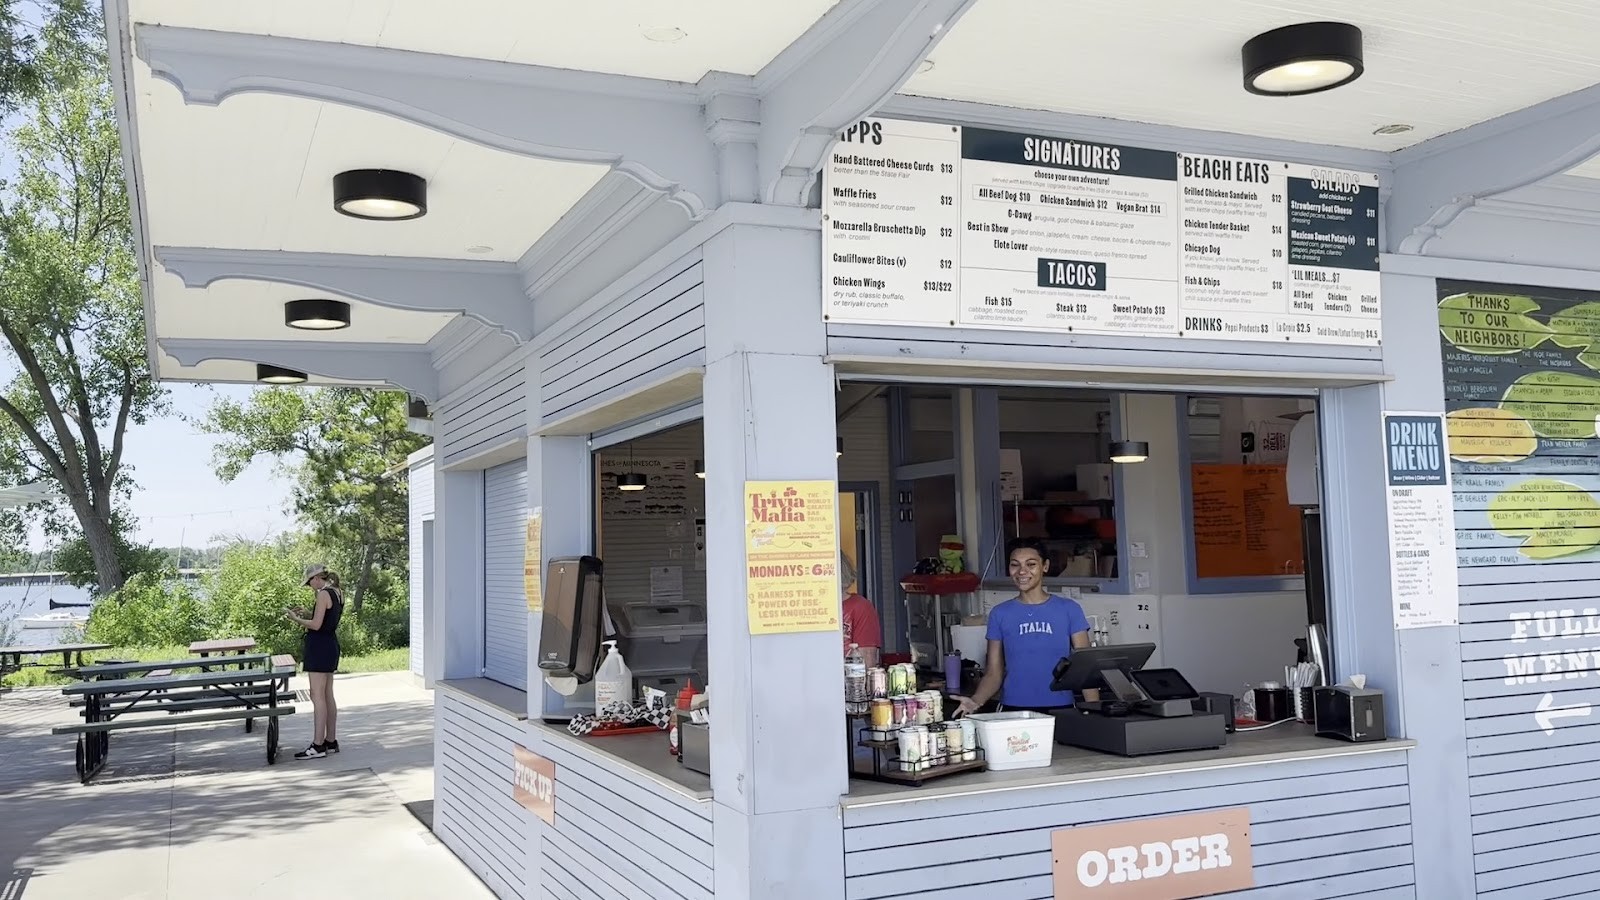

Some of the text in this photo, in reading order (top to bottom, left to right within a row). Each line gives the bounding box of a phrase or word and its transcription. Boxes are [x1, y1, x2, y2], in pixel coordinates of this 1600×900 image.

[841, 120, 883, 146] PPS
[1023, 137, 1121, 171] SIGNATURES
[833, 153, 953, 174] Hand Battered Cheese Curds $13
[1184, 156, 1269, 184] BEACH EATS
[833, 166, 853, 174] better
[869, 169, 880, 177] the
[1034, 170, 1110, 185] choose your own adventure!
[1311, 169, 1360, 195] SALADS
[833, 187, 953, 206] Waffle Fries $12
[979, 188, 1031, 202] All Beef Dog $10
[1040, 194, 1108, 210] Chicken Sandwich $12
[1184, 186, 1282, 203] Grilled Chicken Sandwich $12
[848, 201, 879, 209] seasoned
[1116, 201, 1161, 214] Vegan Brat $14
[1291, 200, 1321, 213] Strawberry
[1321, 203, 1334, 213] Goat
[1333, 204, 1353, 215] Cheese
[1008, 209, 1032, 221] G-Dawg
[833, 220, 953, 237] Mozzarella Bruschetta Dip $12
[967, 221, 1009, 233] Best in Show
[1184, 219, 1282, 234] Chicken Tender Basket $14
[1291, 229, 1314, 240] Mexican
[1314, 231, 1331, 242] Sweet
[1330, 233, 1348, 243] Potato
[994, 239, 1028, 251] Elote Lover
[1184, 243, 1208, 255] Chicago
[1209, 244, 1221, 255] Dog
[1271, 249, 1282, 258] $10
[833, 252, 952, 269] Cauliflower Bites (v) $12
[1047, 261, 1097, 287] TACOS
[833, 276, 952, 292] Chicken Wings $13/$22
[1184, 276, 1197, 286] Fish
[1198, 277, 1203, 286] &
[1203, 277, 1220, 287] Chips
[1272, 281, 1283, 290] $18
[833, 291, 844, 299] dry
[985, 296, 1012, 307] Fish $15
[1293, 290, 1377, 303] All Beef Chicken Grilled
[841, 300, 865, 308] teriyaki
[1056, 303, 1087, 313] Steak $13
[1112, 304, 1166, 315] Sweet Potato $13
[1293, 301, 1302, 309] Hot
[1303, 301, 1314, 311] Dog
[1324, 302, 1344, 311] Tenders
[1360, 305, 1378, 314] Cheese
[1467, 295, 1510, 311] THANKS
[1185, 317, 1222, 332] DRINKS
[1224, 322, 1238, 333] Pepsi
[1239, 323, 1260, 333] Products
[1261, 324, 1269, 334] $3
[1460, 311, 1509, 328] TO OUR
[1296, 323, 1311, 333] $2.5
[1365, 329, 1378, 339] $4.5
[1473, 367, 1493, 375] ANGELA
[1389, 422, 1438, 446] DRINK
[1391, 445, 1440, 471] MENU
[749, 491, 805, 508] Trivia
[752, 506, 805, 522] Mafia
[1396, 550, 1413, 558] BOTTLES
[1417, 550, 1430, 558] CANS
[749, 564, 823, 578] MONDAYS 6
[757, 589, 813, 599] HARNESS THE
[758, 600, 787, 609] POWER
[789, 599, 800, 608] OF
[758, 607, 828, 619] LESS KNOWLEDGE
[1019, 621, 1053, 635] ITALIA
[1509, 608, 1600, 643] FULL
[514, 760, 553, 805] PICK UP
[1076, 832, 1232, 888] ORDER
